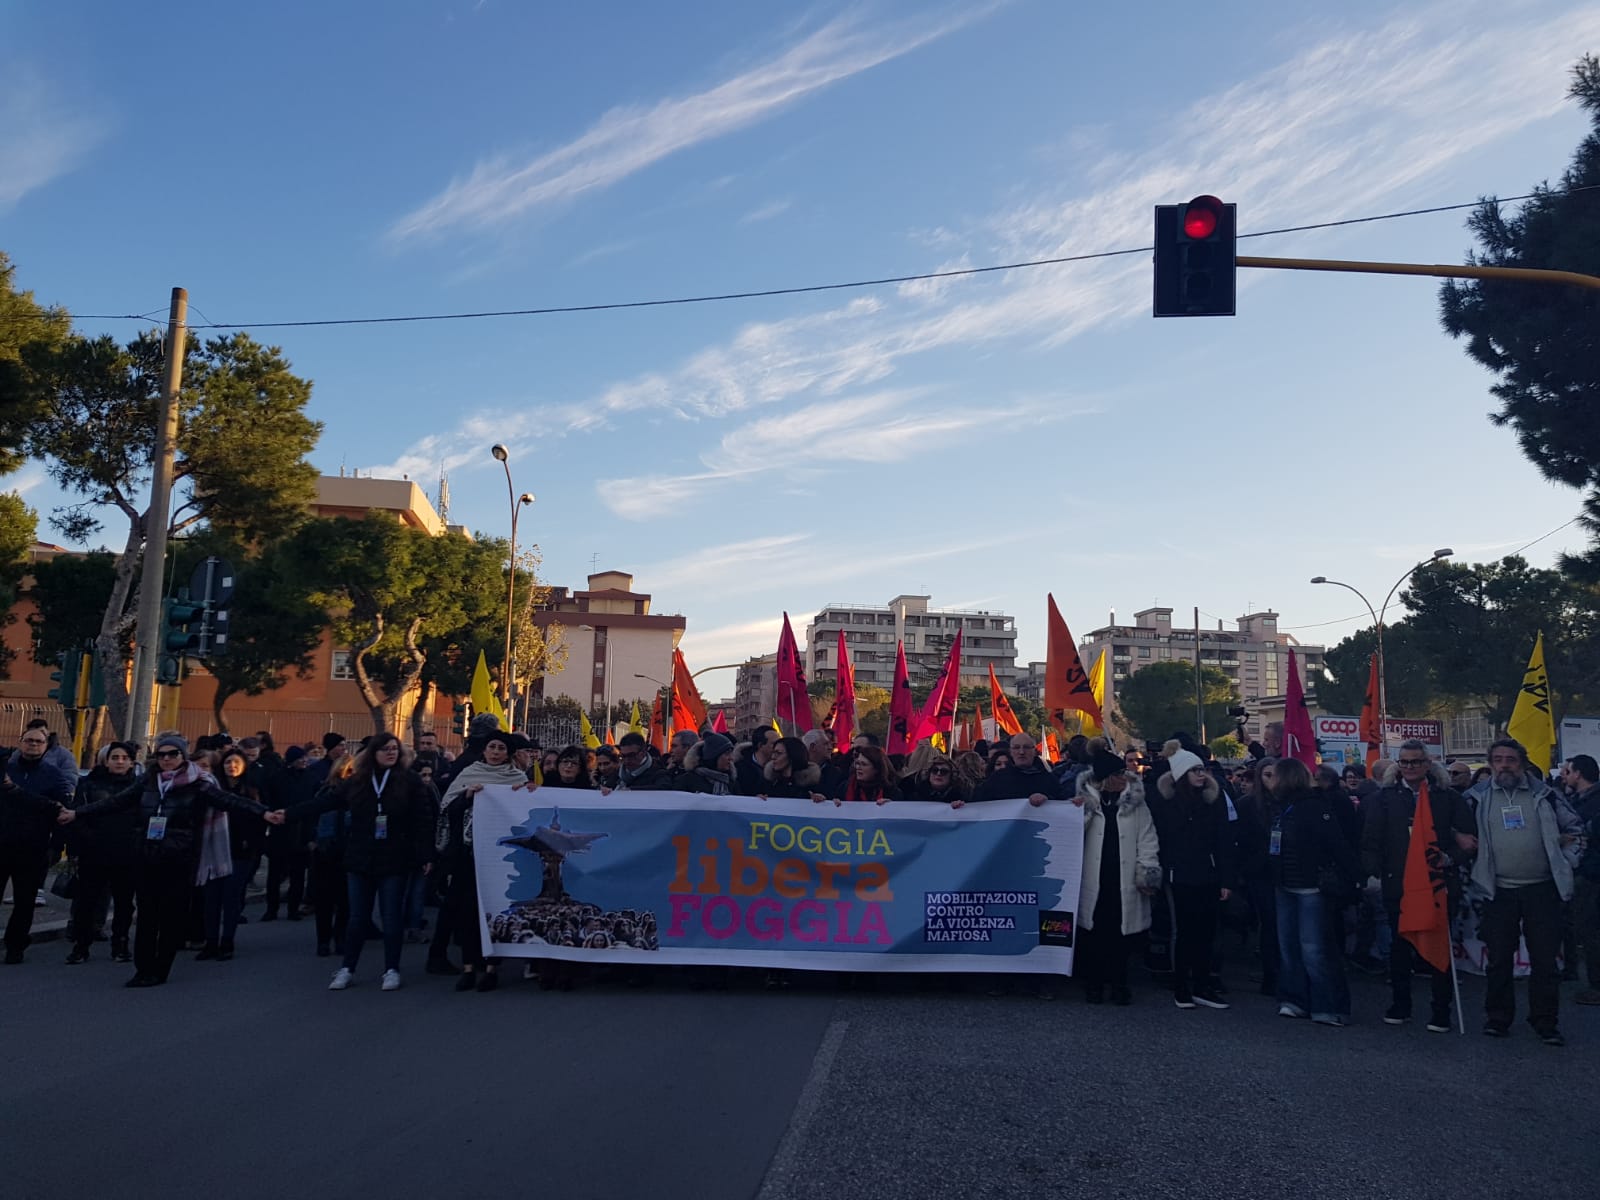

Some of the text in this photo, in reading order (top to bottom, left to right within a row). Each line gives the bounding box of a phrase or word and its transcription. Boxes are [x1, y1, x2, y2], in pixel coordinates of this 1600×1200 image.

[1394, 724, 1438, 737] OFFERTE!
[749, 822, 894, 855] FOGGIA
[668, 836, 894, 902] libera
[927, 893, 1037, 904] MOBILITAZIONE
[927, 905, 984, 917] CONTRO
[666, 895, 894, 944] FOGGIA
[927, 918, 1015, 929] LA VIOLENZA
[927, 930, 990, 941] MAFIOSA
